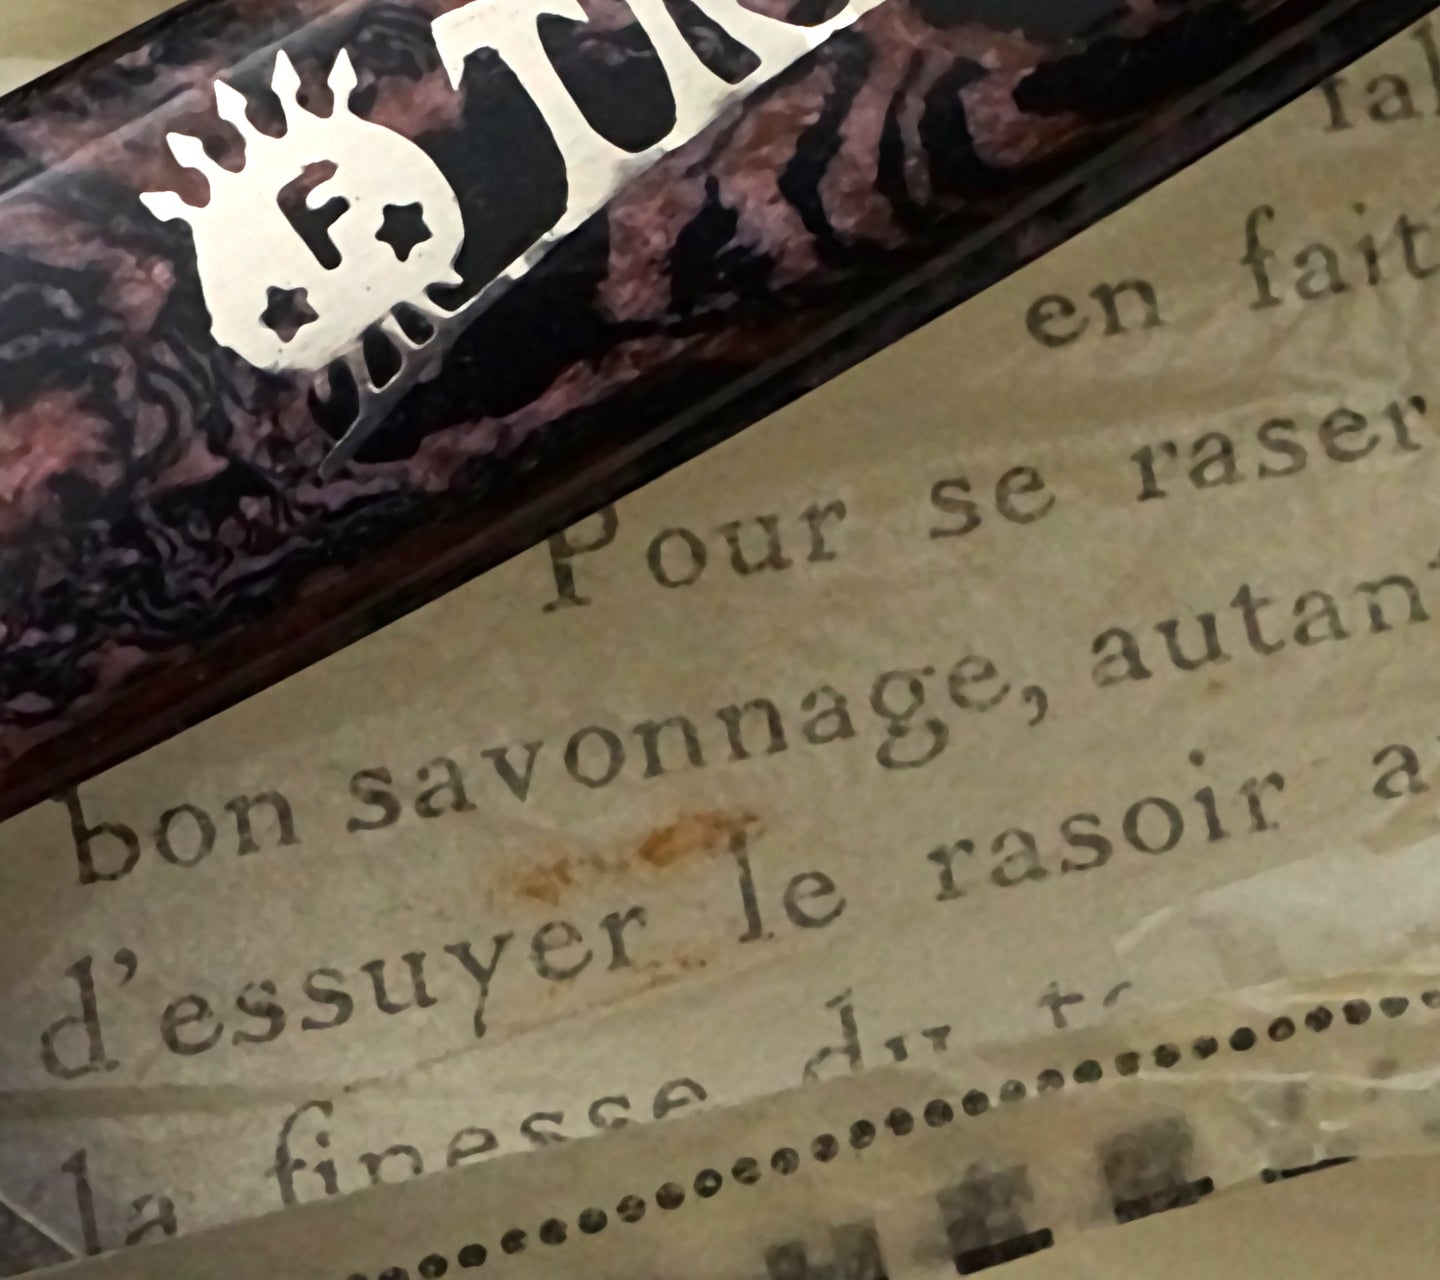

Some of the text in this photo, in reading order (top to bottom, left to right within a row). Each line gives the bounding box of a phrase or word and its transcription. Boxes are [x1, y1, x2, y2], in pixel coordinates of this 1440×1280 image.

[276, 158, 351, 271] F
[1025, 278, 1163, 350] en
[541, 498, 848, 614] Pour
[926, 462, 1056, 544] se
[1134, 394, 1427, 504] raser
[49, 782, 301, 888] bon
[344, 652, 1051, 836] savonnage,
[728, 814, 850, 945] le
[926, 746, 1288, 905] rasoir
[59, 1146, 183, 1259] la
